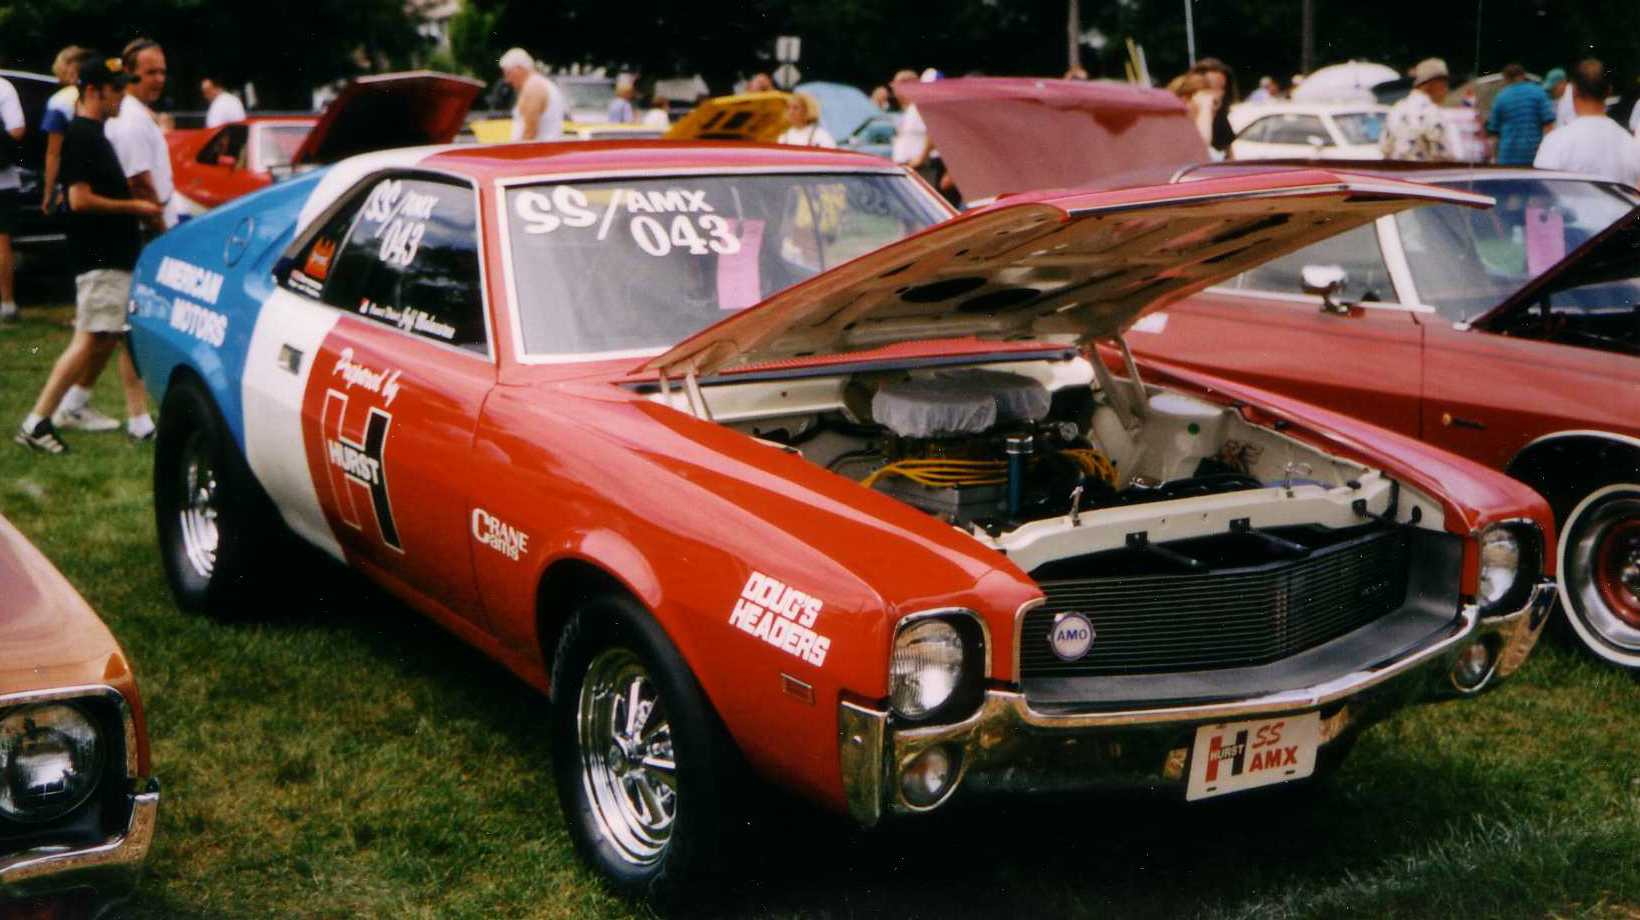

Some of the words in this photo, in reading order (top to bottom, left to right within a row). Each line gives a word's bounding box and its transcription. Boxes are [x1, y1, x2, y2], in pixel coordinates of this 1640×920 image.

[379, 220, 424, 266] 043
[630, 215, 740, 255] 043
[170, 298, 228, 347] MOTORS
[328, 440, 379, 485] HURST
[741, 571, 823, 628] DOUG'S
[729, 598, 831, 667] HEADERS
[1057, 629, 1087, 641] AMO
[1210, 744, 1244, 761] HURST
[1253, 722, 1285, 748] SS
[1249, 745, 1298, 772] AMX
